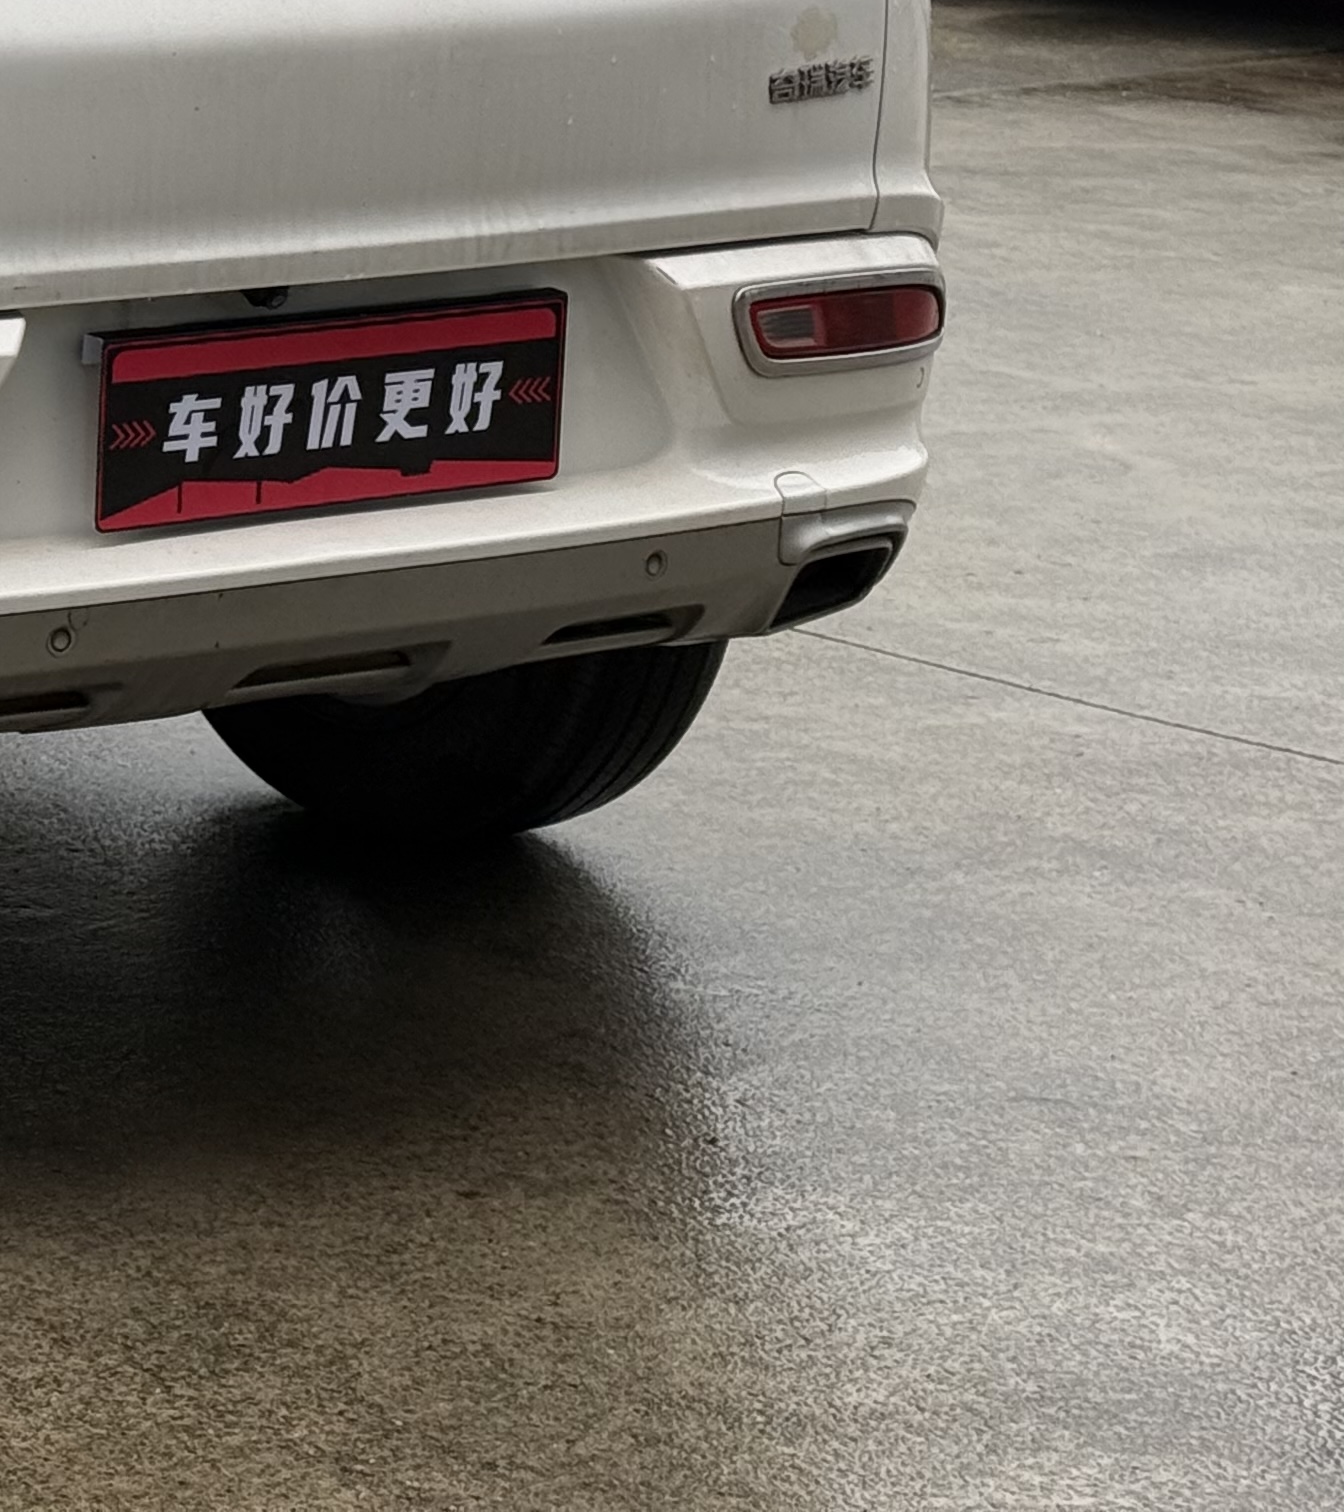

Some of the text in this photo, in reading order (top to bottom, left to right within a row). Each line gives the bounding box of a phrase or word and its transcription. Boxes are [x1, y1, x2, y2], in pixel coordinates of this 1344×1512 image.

[161, 360, 505, 463] 车好价更好
